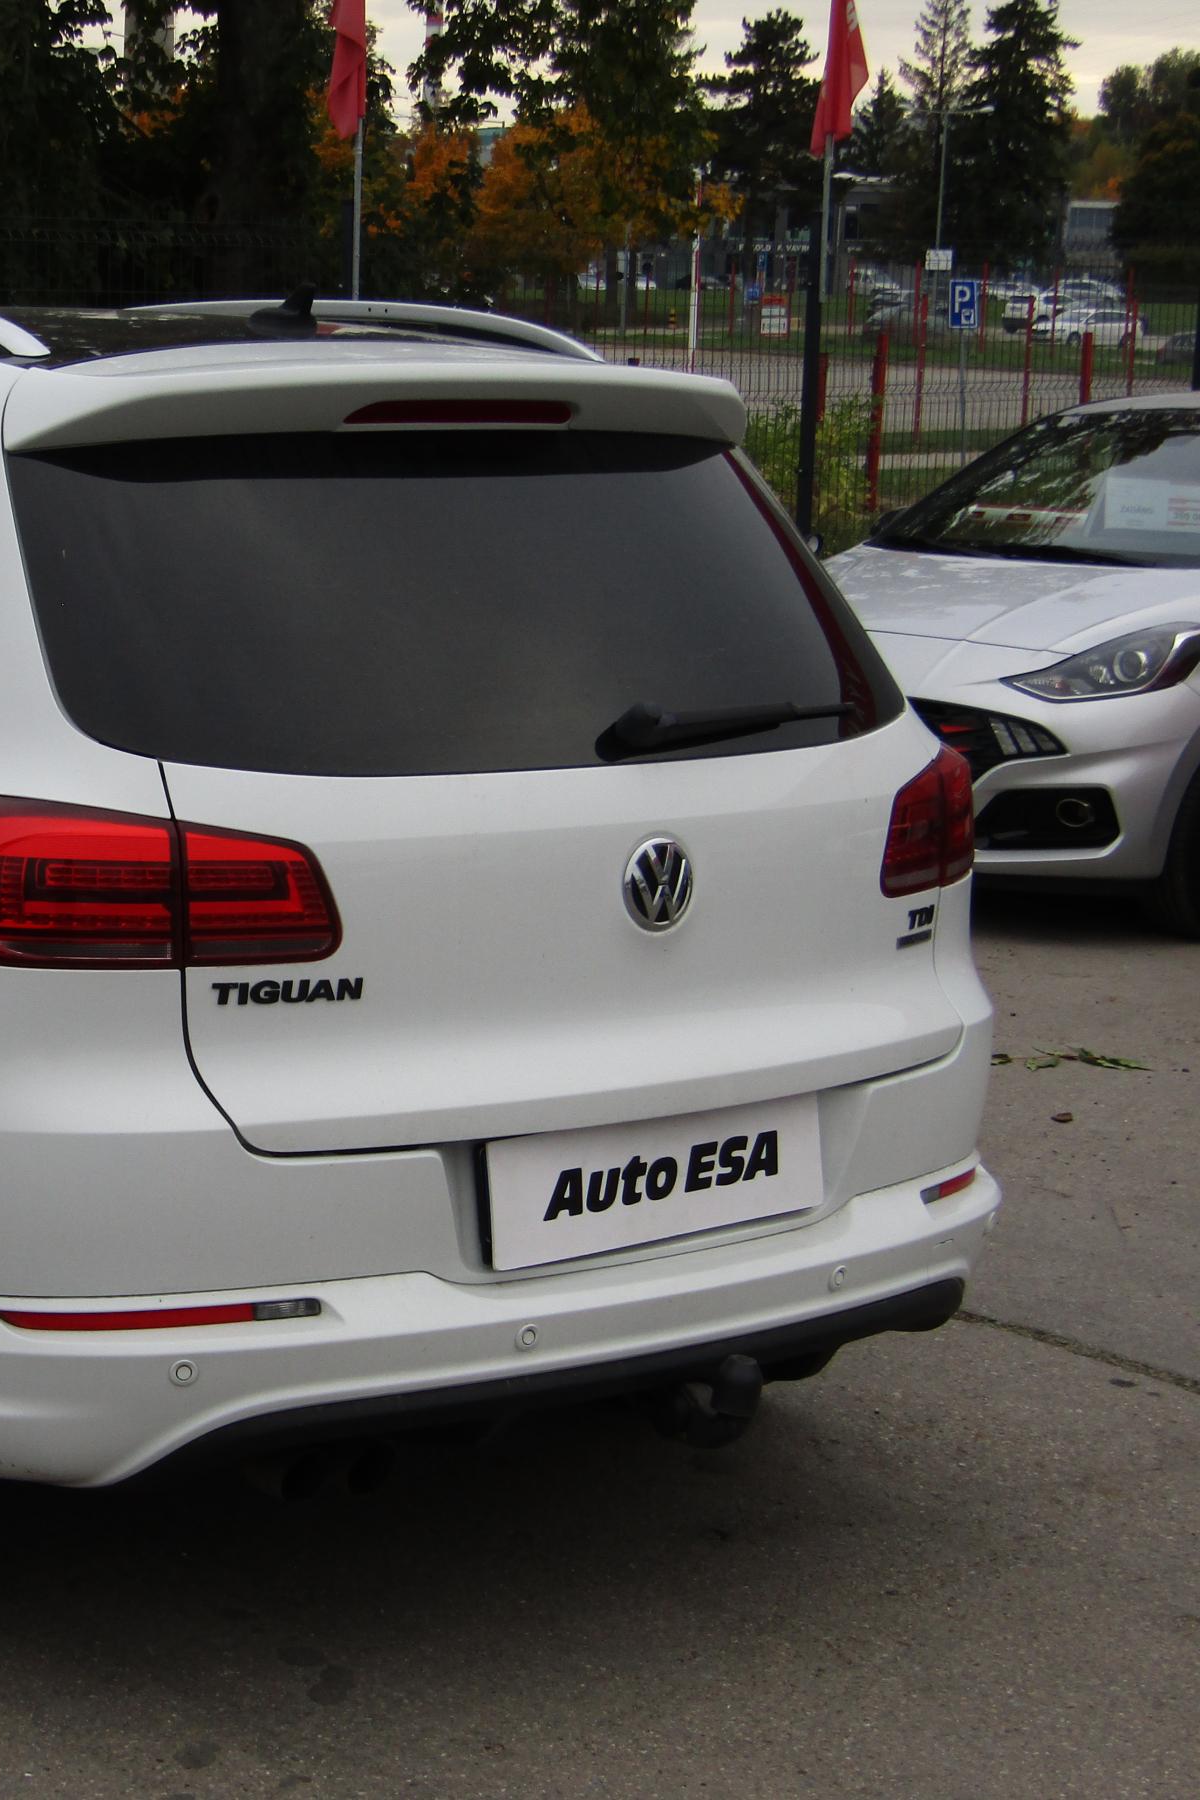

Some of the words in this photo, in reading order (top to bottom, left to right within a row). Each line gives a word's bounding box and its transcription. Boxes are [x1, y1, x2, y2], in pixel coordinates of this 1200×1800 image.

[955, 285, 971, 313] P
[622, 837, 693, 932] VW
[908, 904, 935, 930] TDI
[212, 977, 364, 1005] TIGUAN
[543, 1155, 678, 1221] Auto
[684, 1130, 778, 1193] ESA
